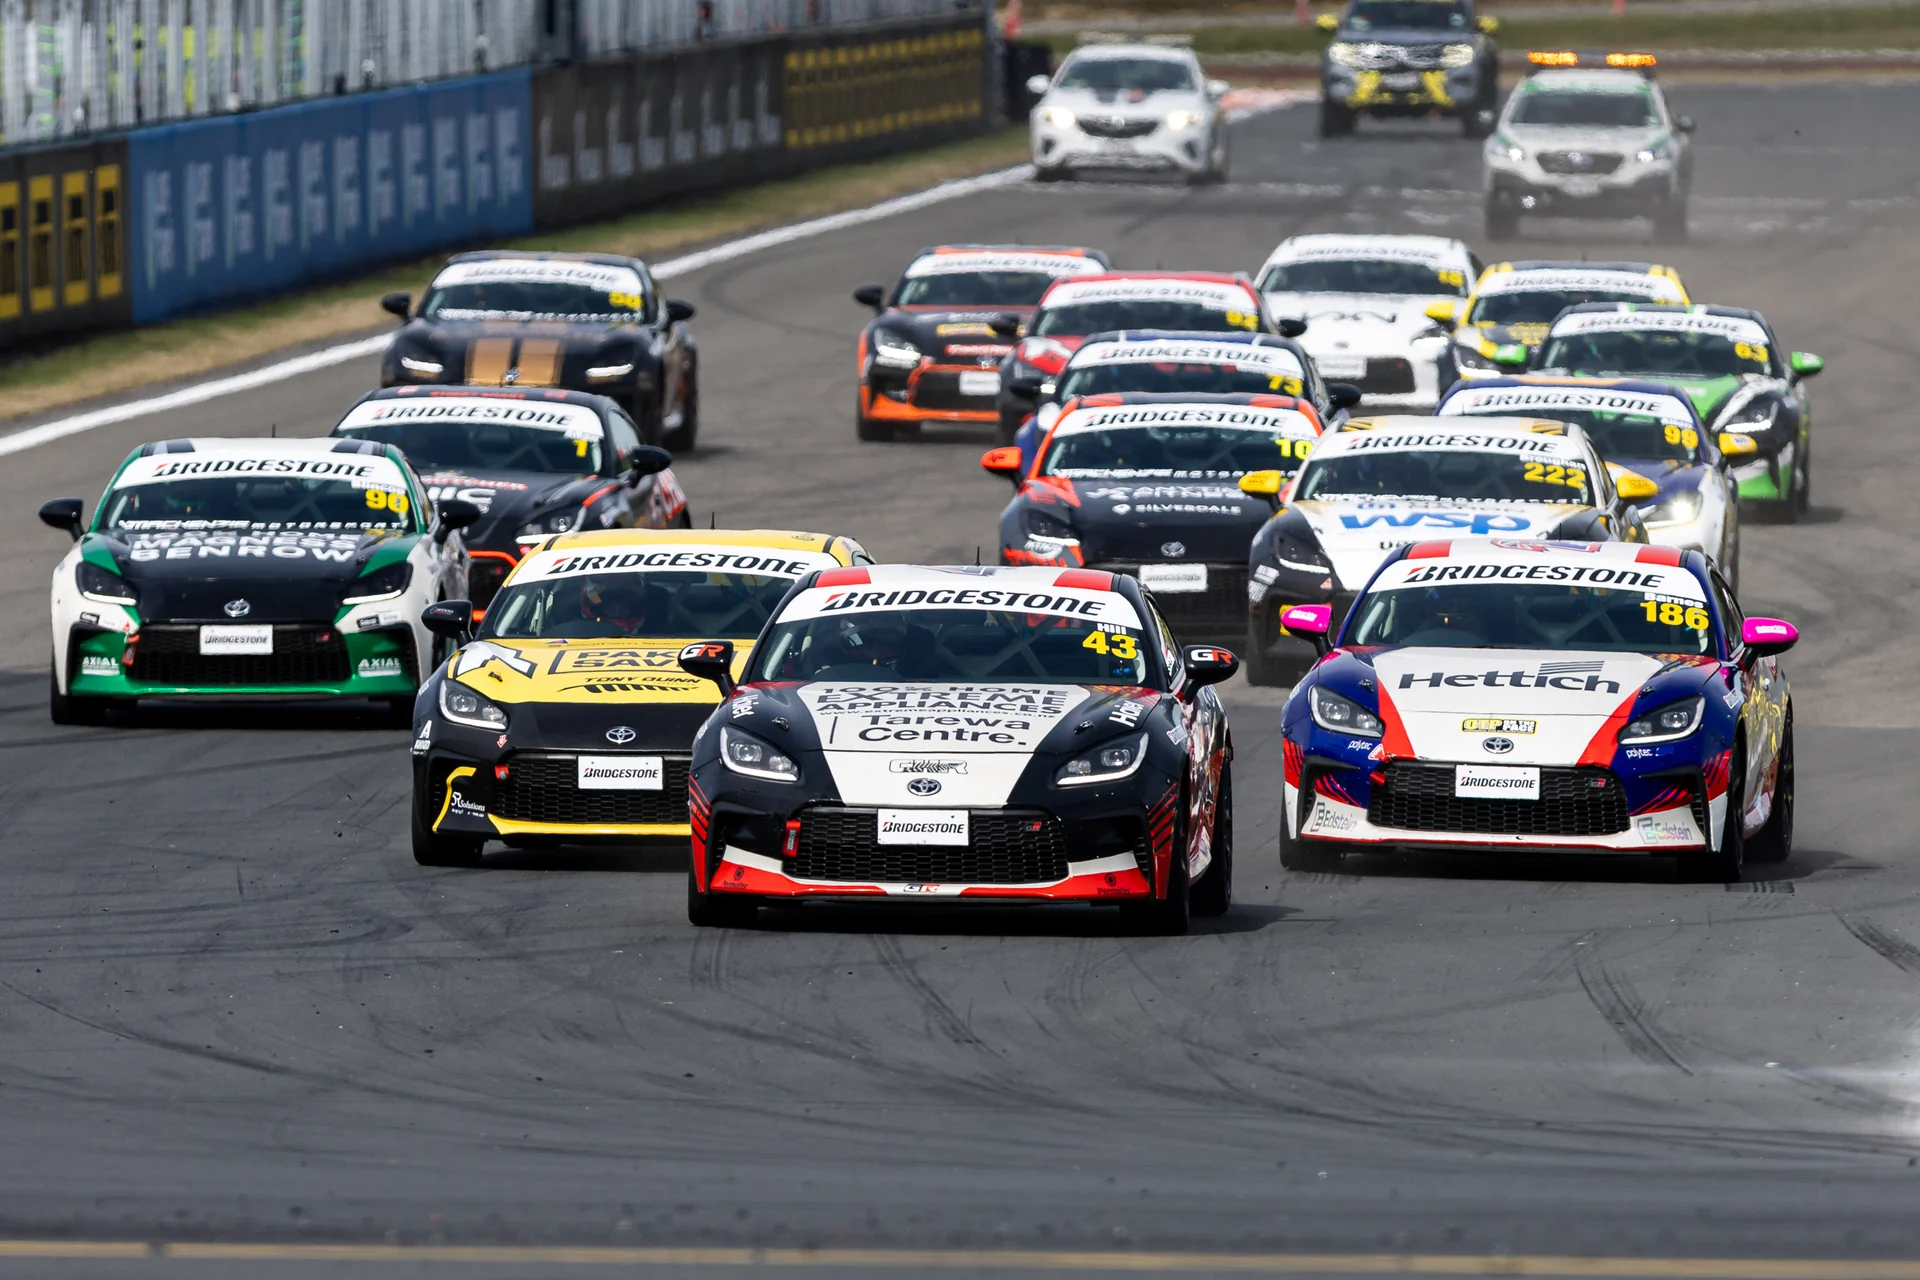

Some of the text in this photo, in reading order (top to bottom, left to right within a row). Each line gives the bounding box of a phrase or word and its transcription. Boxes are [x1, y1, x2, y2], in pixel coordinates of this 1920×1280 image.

[1098, 346, 1275, 364] BRIDGESTONE
[1266, 372, 1304, 395] 73
[1472, 392, 1663, 412] BRIDGESTONE
[369, 405, 576, 427] BRIDGESTONE
[1084, 408, 1288, 428] BRIDGESTONE
[1350, 434, 1558, 454] BRIDGESTONE
[1663, 424, 1700, 449] 99
[572, 438, 589, 458] 1
[1275, 438, 1313, 459] 10
[152, 459, 375, 478] BRIDGESTONE
[1523, 461, 1586, 489] 222
[365, 488, 410, 513] 90
[1135, 503, 1242, 515] SILVERDALE
[132, 537, 357, 550] MAGNESS
[129, 545, 357, 562] BENROW
[546, 552, 811, 576] BRIDGESTONE
[1402, 563, 1666, 588] BRIDGESTONE
[819, 588, 1107, 617] BRIDGESTONE
[1643, 592, 1705, 608] Barnes
[1640, 600, 1710, 631] 186
[204, 635, 269, 645] BRIDGESTONE
[1082, 630, 1138, 660] 43
[679, 643, 726, 660] GR
[1190, 648, 1234, 665] GR
[83, 657, 118, 667] AXIAL
[358, 658, 400, 668] AXIAL
[584, 676, 639, 685] TONY
[642, 676, 701, 685] QUINN
[1398, 670, 1621, 695] Hettich
[816, 691, 1068, 707] EXTREME
[823, 686, 1070, 697] 100% HOME
[815, 700, 1064, 716] APPLIANCES
[819, 708, 1056, 719] www.extremeappliances.co.nz
[861, 714, 1032, 730] Tarewa
[1464, 719, 1503, 731] OTP
[857, 726, 1028, 746] Centre.
[1347, 739, 1374, 751] polytec
[1625, 747, 1654, 760] polytec
[583, 767, 660, 779] BRIDGESTONE
[1459, 776, 1536, 789] BRIDGESTONE
[881, 821, 966, 835] BRIDGESTONE
[1321, 810, 1358, 833] Edstein
[1654, 822, 1693, 841] Edstein
[903, 883, 942, 893] GR
